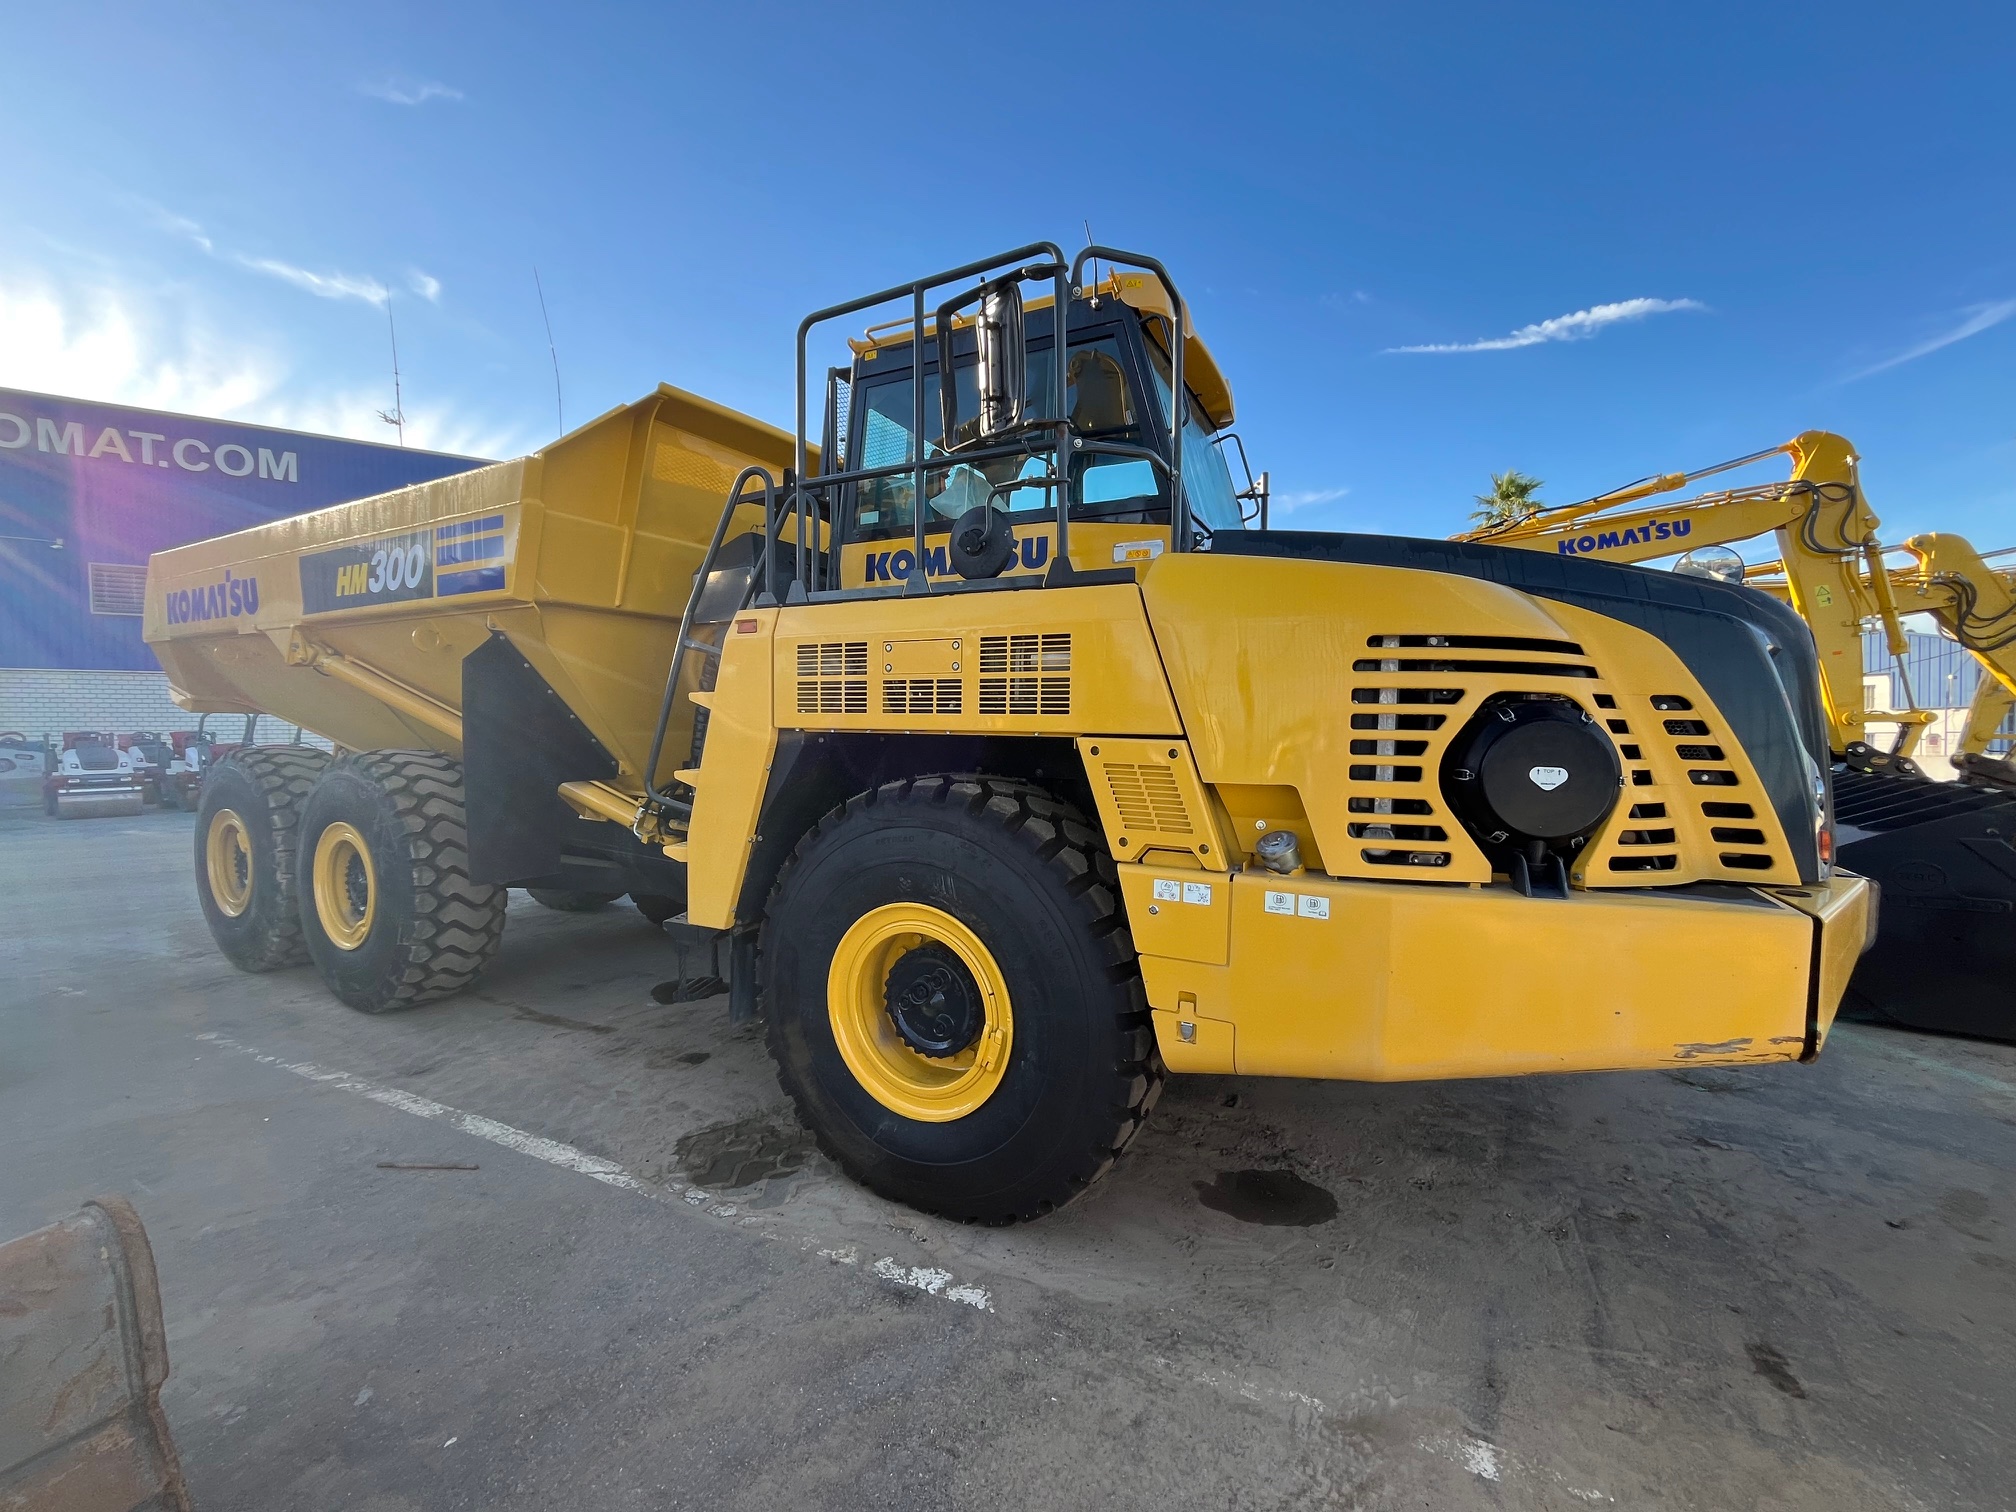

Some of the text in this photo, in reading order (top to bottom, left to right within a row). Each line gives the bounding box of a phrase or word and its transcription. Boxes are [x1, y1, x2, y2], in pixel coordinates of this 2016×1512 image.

[0, 412, 299, 483] OMAT.COM
[865, 536, 1048, 582] KOMU
[1557, 518, 1691, 555] KOMATSU
[166, 569, 260, 625] KOMATSU
[335, 543, 426, 598] HM300
